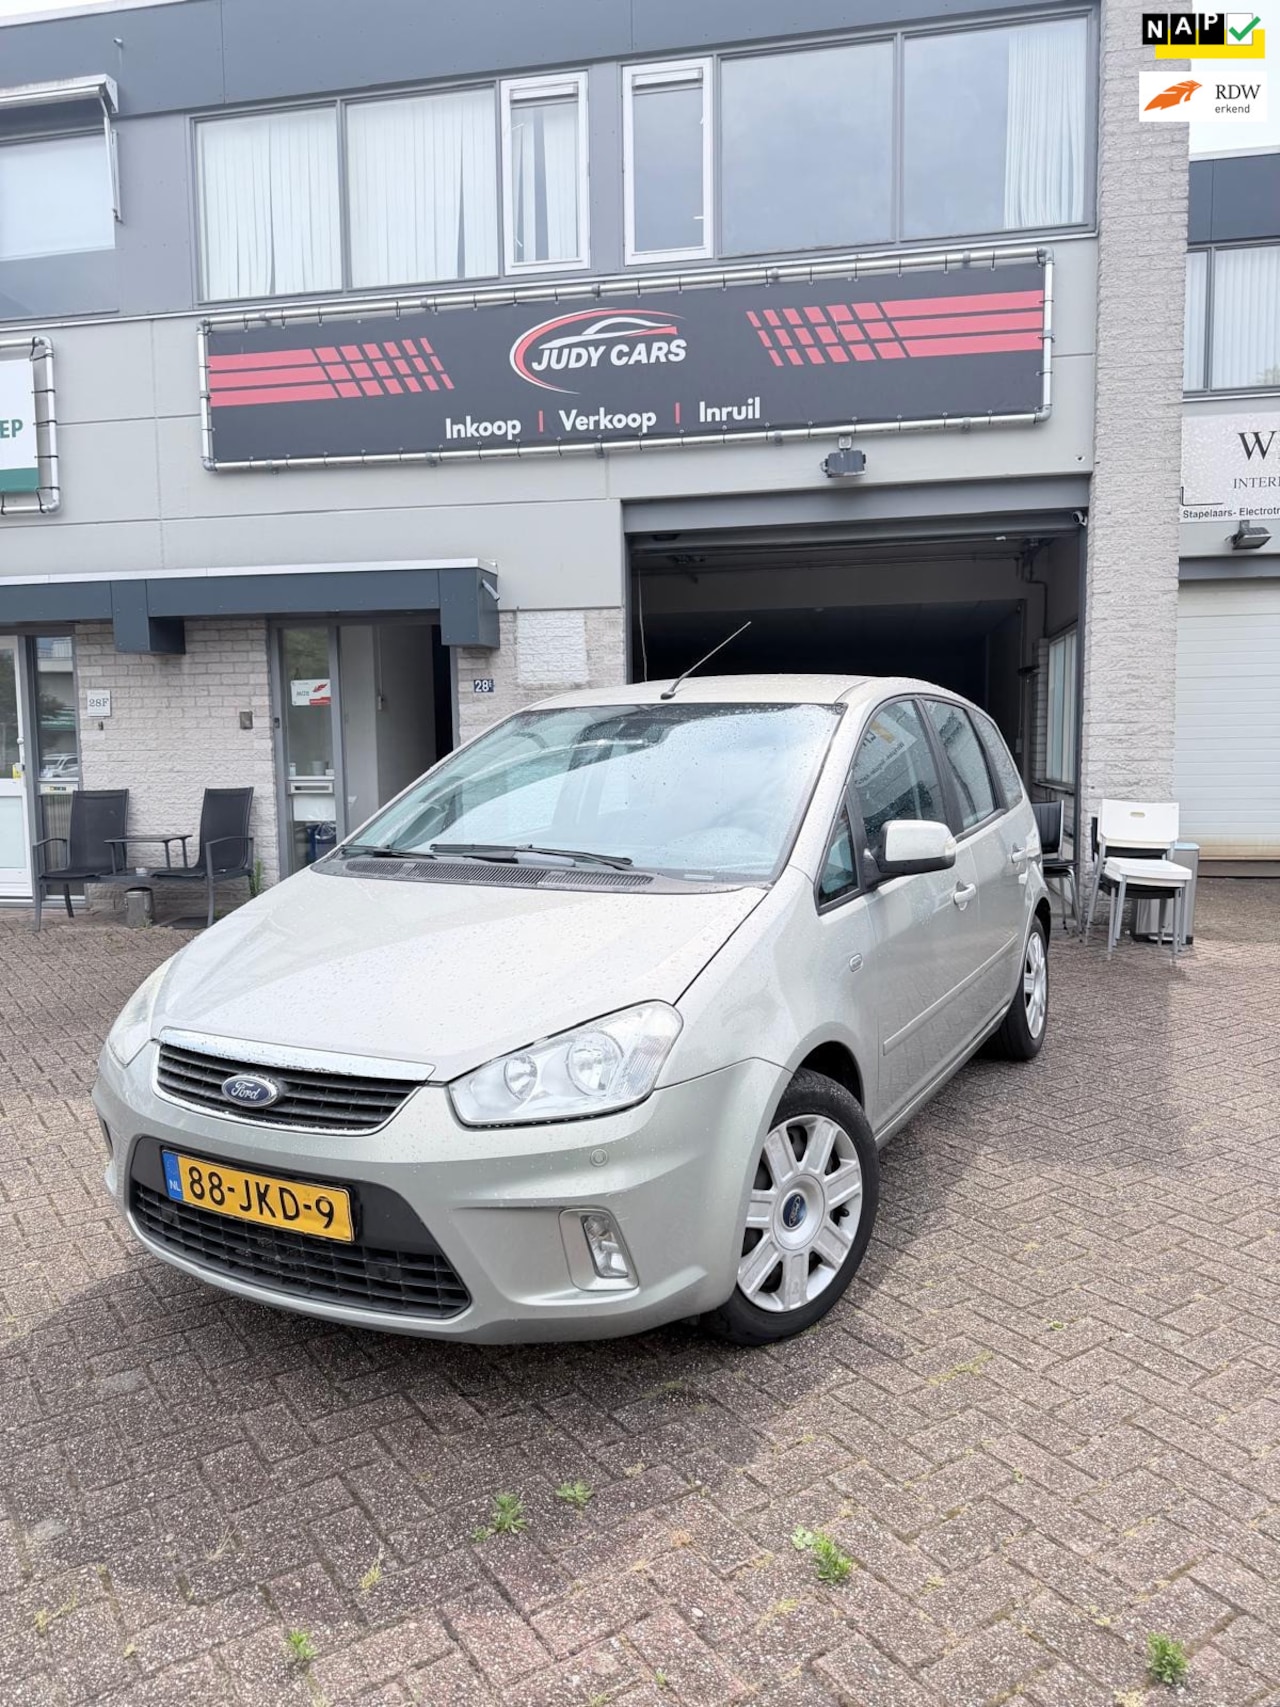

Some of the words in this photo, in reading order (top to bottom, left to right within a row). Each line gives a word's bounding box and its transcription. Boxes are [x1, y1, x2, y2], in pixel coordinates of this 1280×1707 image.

[532, 346, 605, 371] JUDY
[610, 339, 687, 366] CARS
[445, 415, 522, 440] Inkoop
[559, 407, 657, 433] Verkoop
[699, 397, 761, 423] Inruil
[1237, 430, 1280, 461] W
[1183, 508, 1237, 519] Stapelaars-
[89, 697, 110, 707] 28F
[231, 1080, 261, 1099] Ford
[169, 1179, 181, 1191] NL
[188, 1166, 334, 1229] 88-JKD-9
